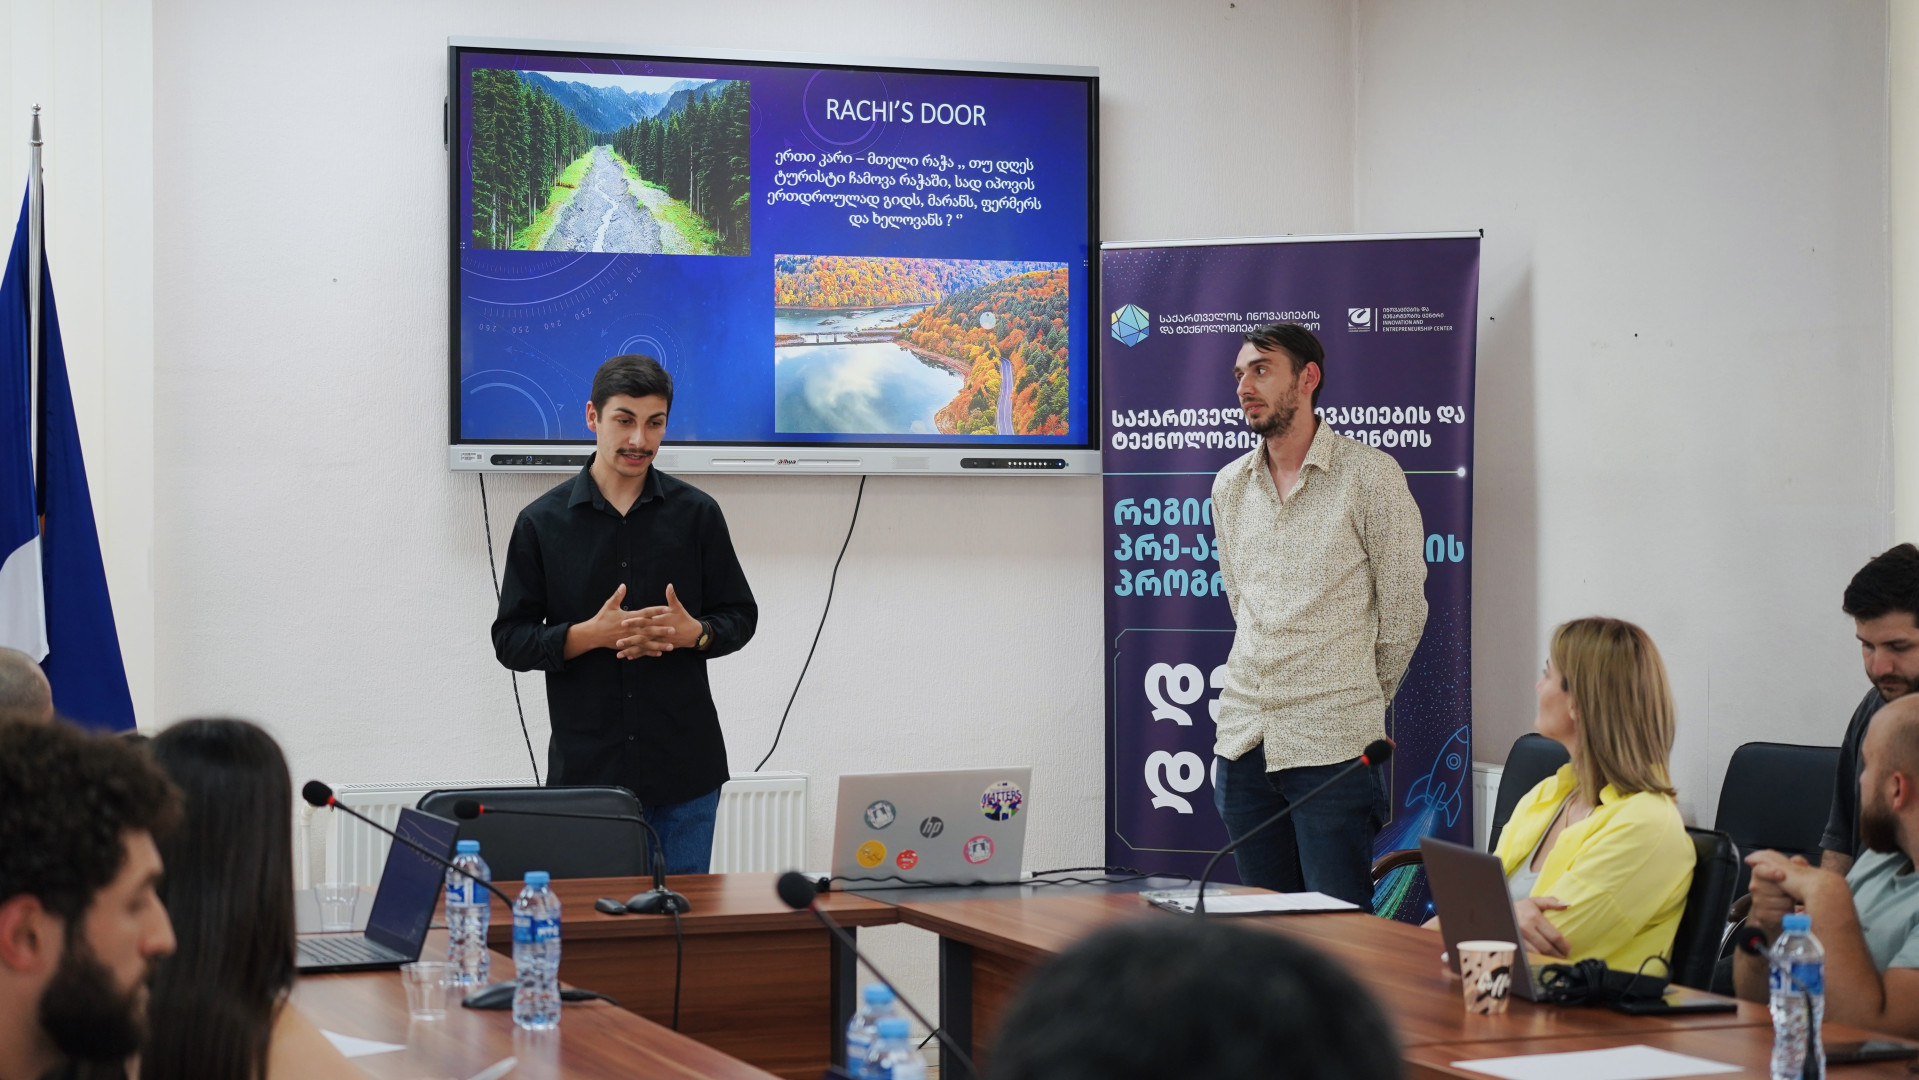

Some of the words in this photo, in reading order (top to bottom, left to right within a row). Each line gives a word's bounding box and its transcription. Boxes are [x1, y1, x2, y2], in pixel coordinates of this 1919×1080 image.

[920, 102, 987, 127] DOOR
[775, 148, 816, 166] ერთი
[818, 150, 853, 168] კარი
[867, 151, 919, 171] მთელი
[921, 153, 955, 172] რაჭა
[968, 159, 993, 174] თუ
[996, 157, 1035, 175] დღეს
[774, 168, 846, 188] ტურისტი
[848, 170, 897, 190] ჩამოვა
[899, 172, 952, 191] რაჭაში,
[954, 174, 982, 193] სად
[985, 176, 1035, 194] იპოვის
[766, 187, 881, 209] ერთდროულად
[883, 192, 925, 211] გიდს,
[927, 193, 978, 210] მარანს,
[980, 195, 1042, 214] ფერმერს
[848, 213, 870, 229] და
[871, 211, 944, 231] ხელოვანს
[945, 213, 953, 227] ?
[1159, 313, 1243, 324] საქართველოს
[1246, 310, 1321, 321] ინოვაციების
[1159, 325, 1174, 335] და
[1111, 407, 1250, 428] საქართველ
[1313, 405, 1431, 425] ვაციების
[1436, 405, 1467, 425] და
[1111, 430, 1265, 451] ტექნოლოგიე
[981, 789, 1023, 804] MATTERS
[921, 816, 943, 839] hp
